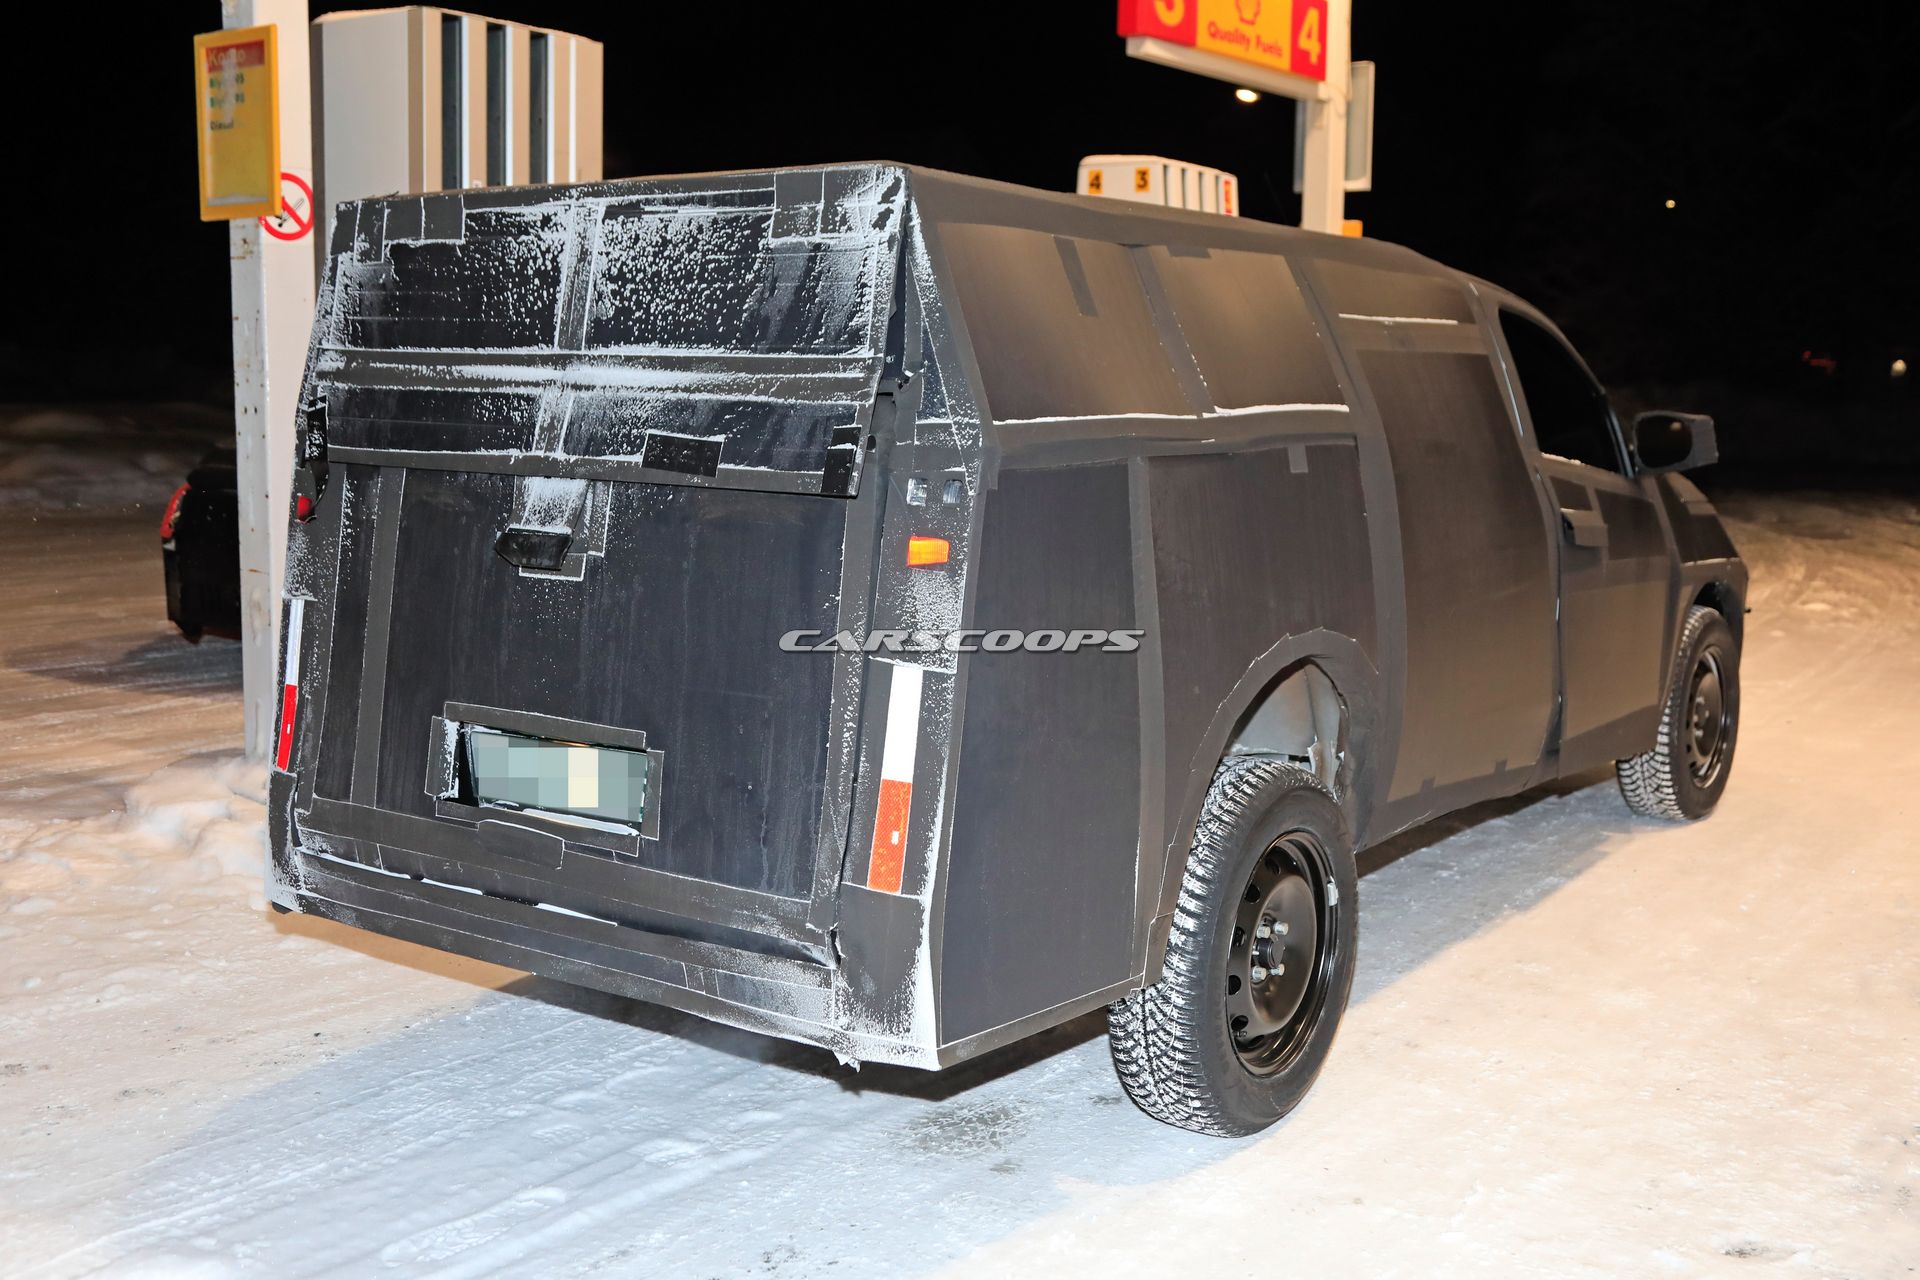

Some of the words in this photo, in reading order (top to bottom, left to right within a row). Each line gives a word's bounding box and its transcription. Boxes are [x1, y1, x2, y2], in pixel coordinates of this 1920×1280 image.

[1207, 20, 1251, 51] Quality
[1256, 33, 1283, 57] Fuels
[1298, 6, 1321, 65] 4
[1089, 172, 1101, 190] 4
[1136, 170, 1148, 188] 3
